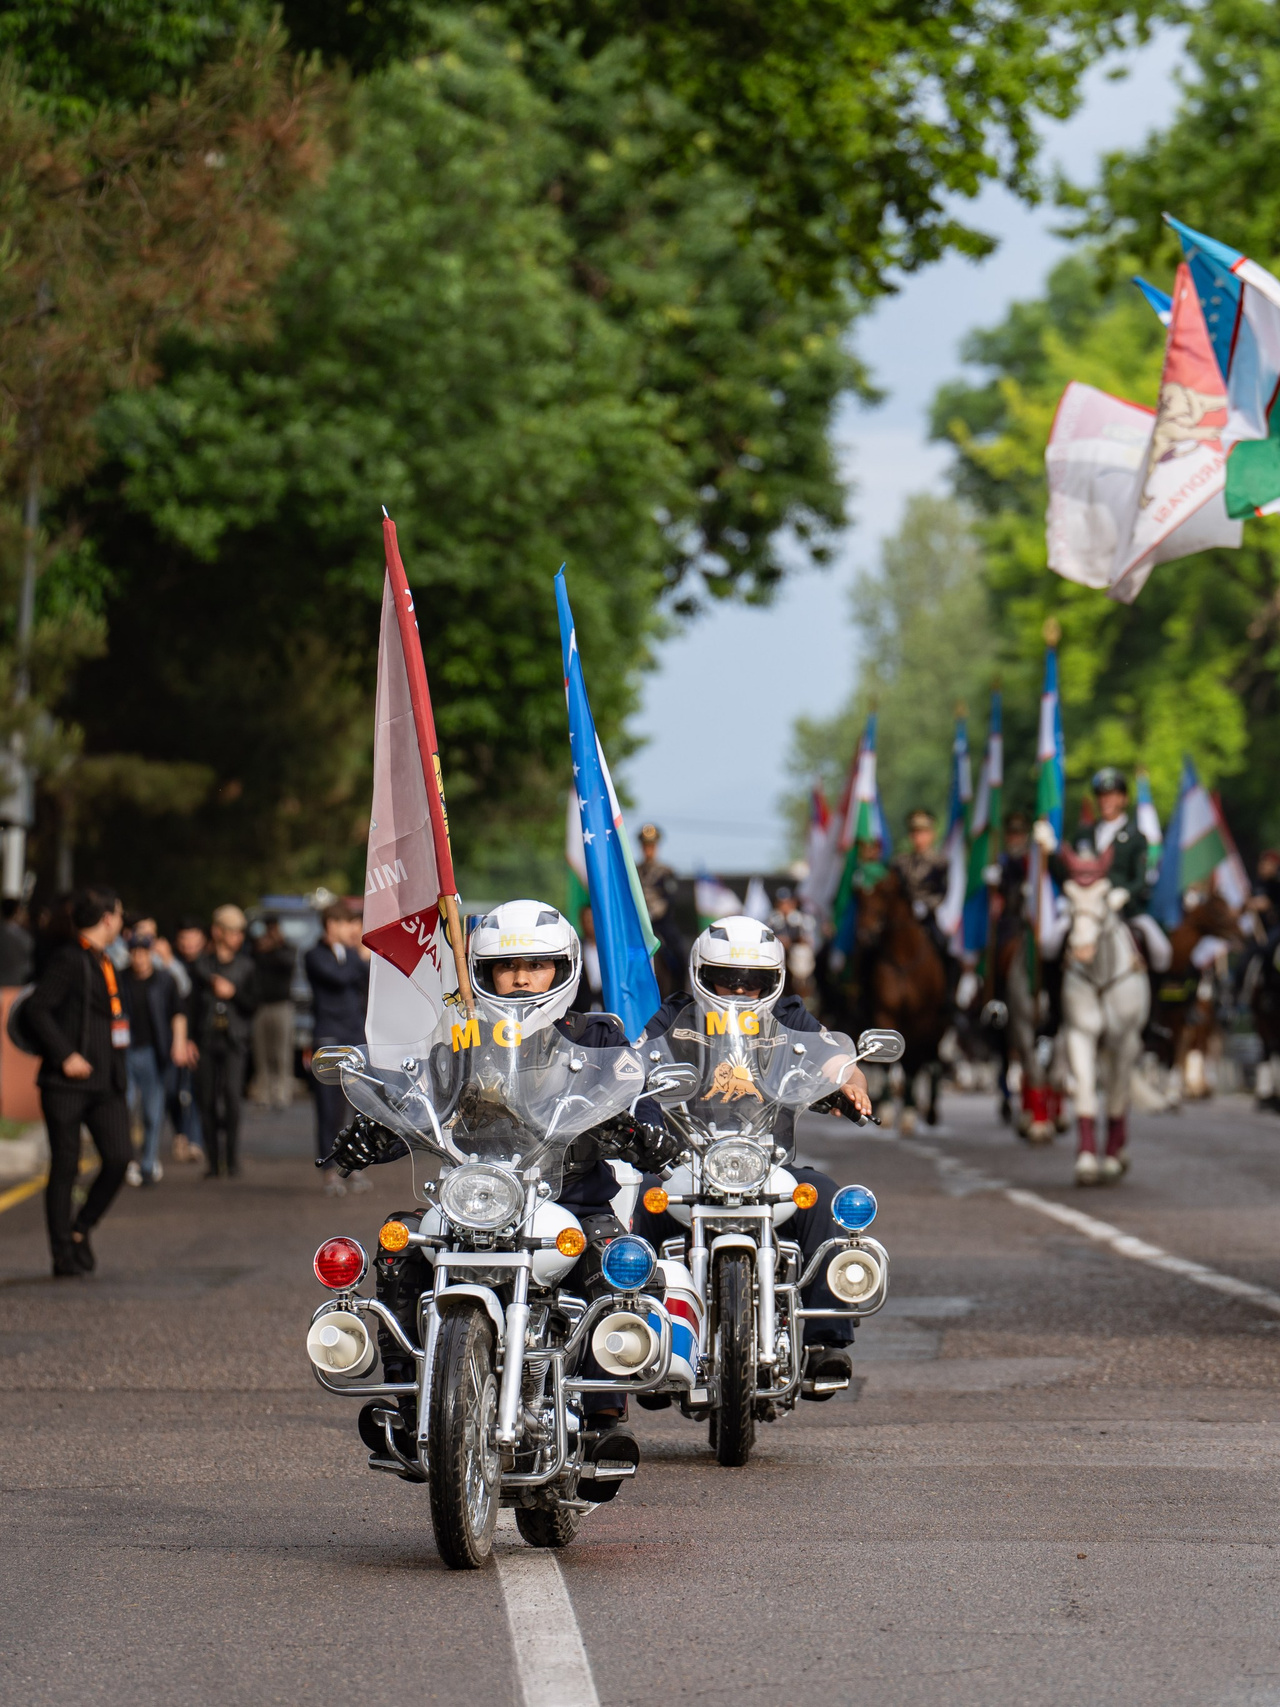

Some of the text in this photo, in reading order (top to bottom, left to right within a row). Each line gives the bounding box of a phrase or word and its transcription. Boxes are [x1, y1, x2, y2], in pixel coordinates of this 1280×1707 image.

[500, 933, 535, 948] MG
[731, 946, 759, 960] MG
[706, 1010, 760, 1036] MG
